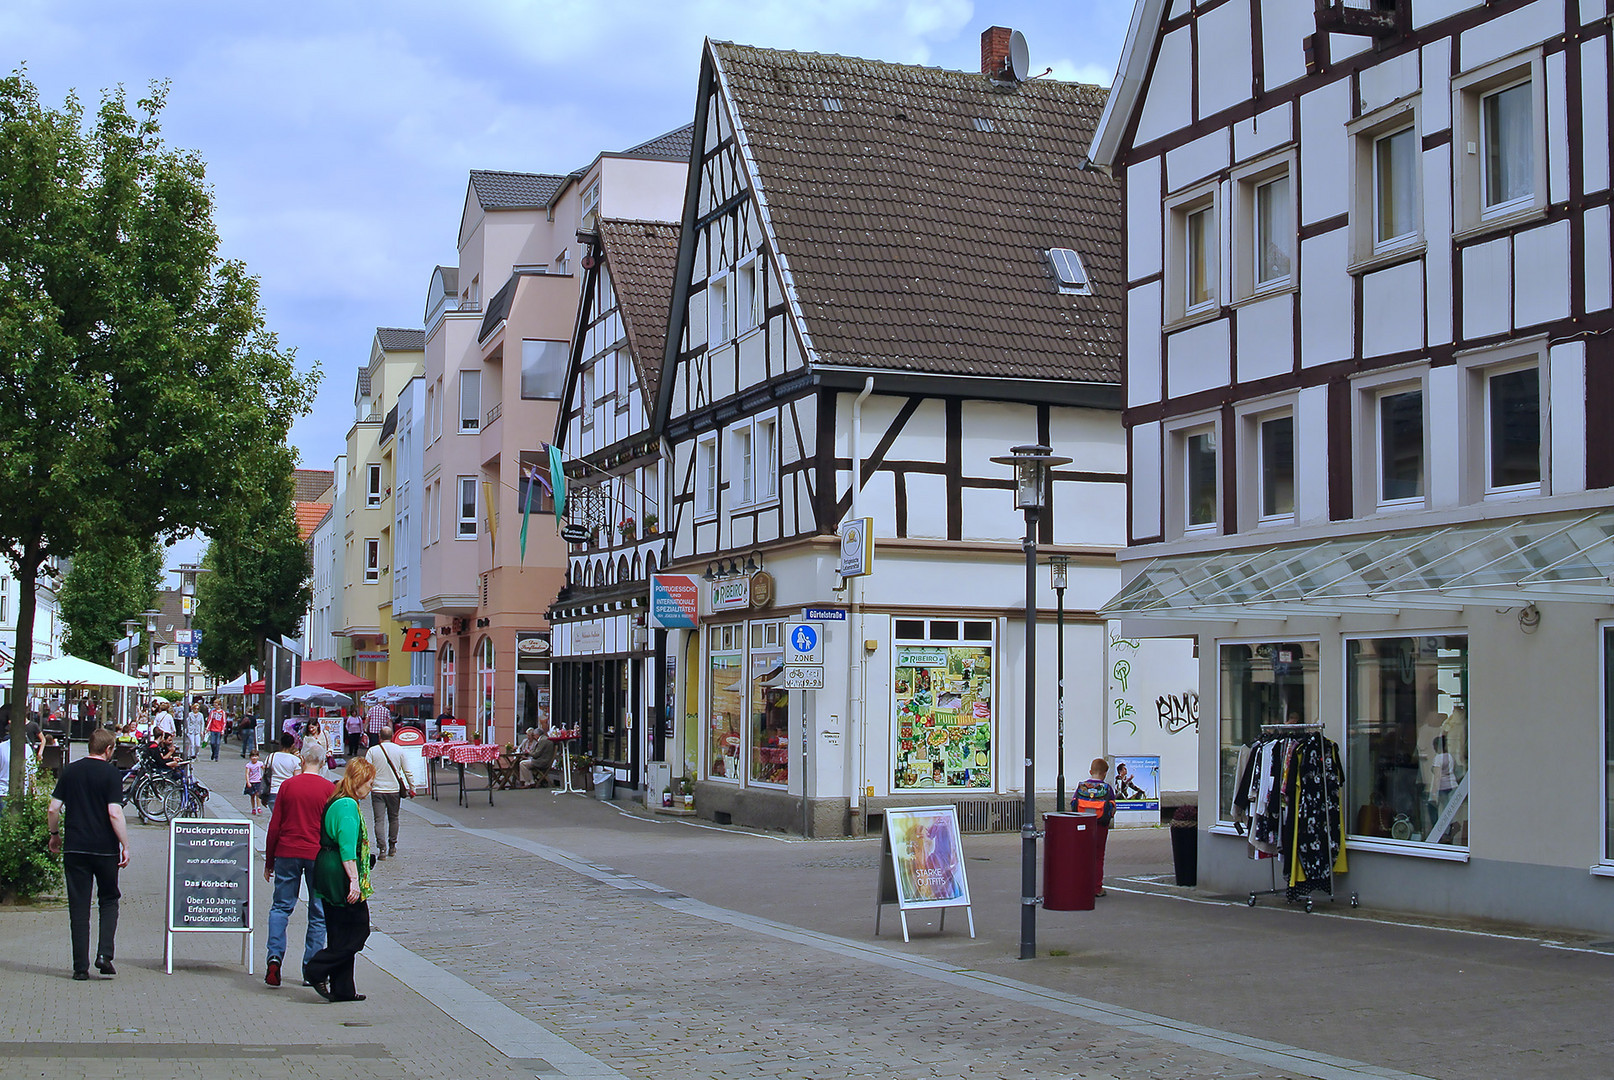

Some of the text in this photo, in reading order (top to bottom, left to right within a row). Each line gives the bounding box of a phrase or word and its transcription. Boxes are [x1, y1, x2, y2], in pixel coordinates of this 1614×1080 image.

[720, 583, 743, 604] RIBEIRO
[655, 605, 696, 613] SPEZIALITÄTEN
[809, 610, 843, 619] Gürtelstraße
[401, 628, 431, 652] B
[794, 654, 814, 662] ZONE
[909, 655, 939, 663] RIBEIRO
[175, 826, 250, 835] Druckerpatronen
[189, 839, 235, 847] und Toner
[915, 868, 943, 878] STARKE
[201, 880, 239, 888] Körbchen
[917, 876, 947, 887] OUTFITS
[186, 896, 237, 905] Über 10 Jahre
[187, 906, 223, 914] Erfahrung
